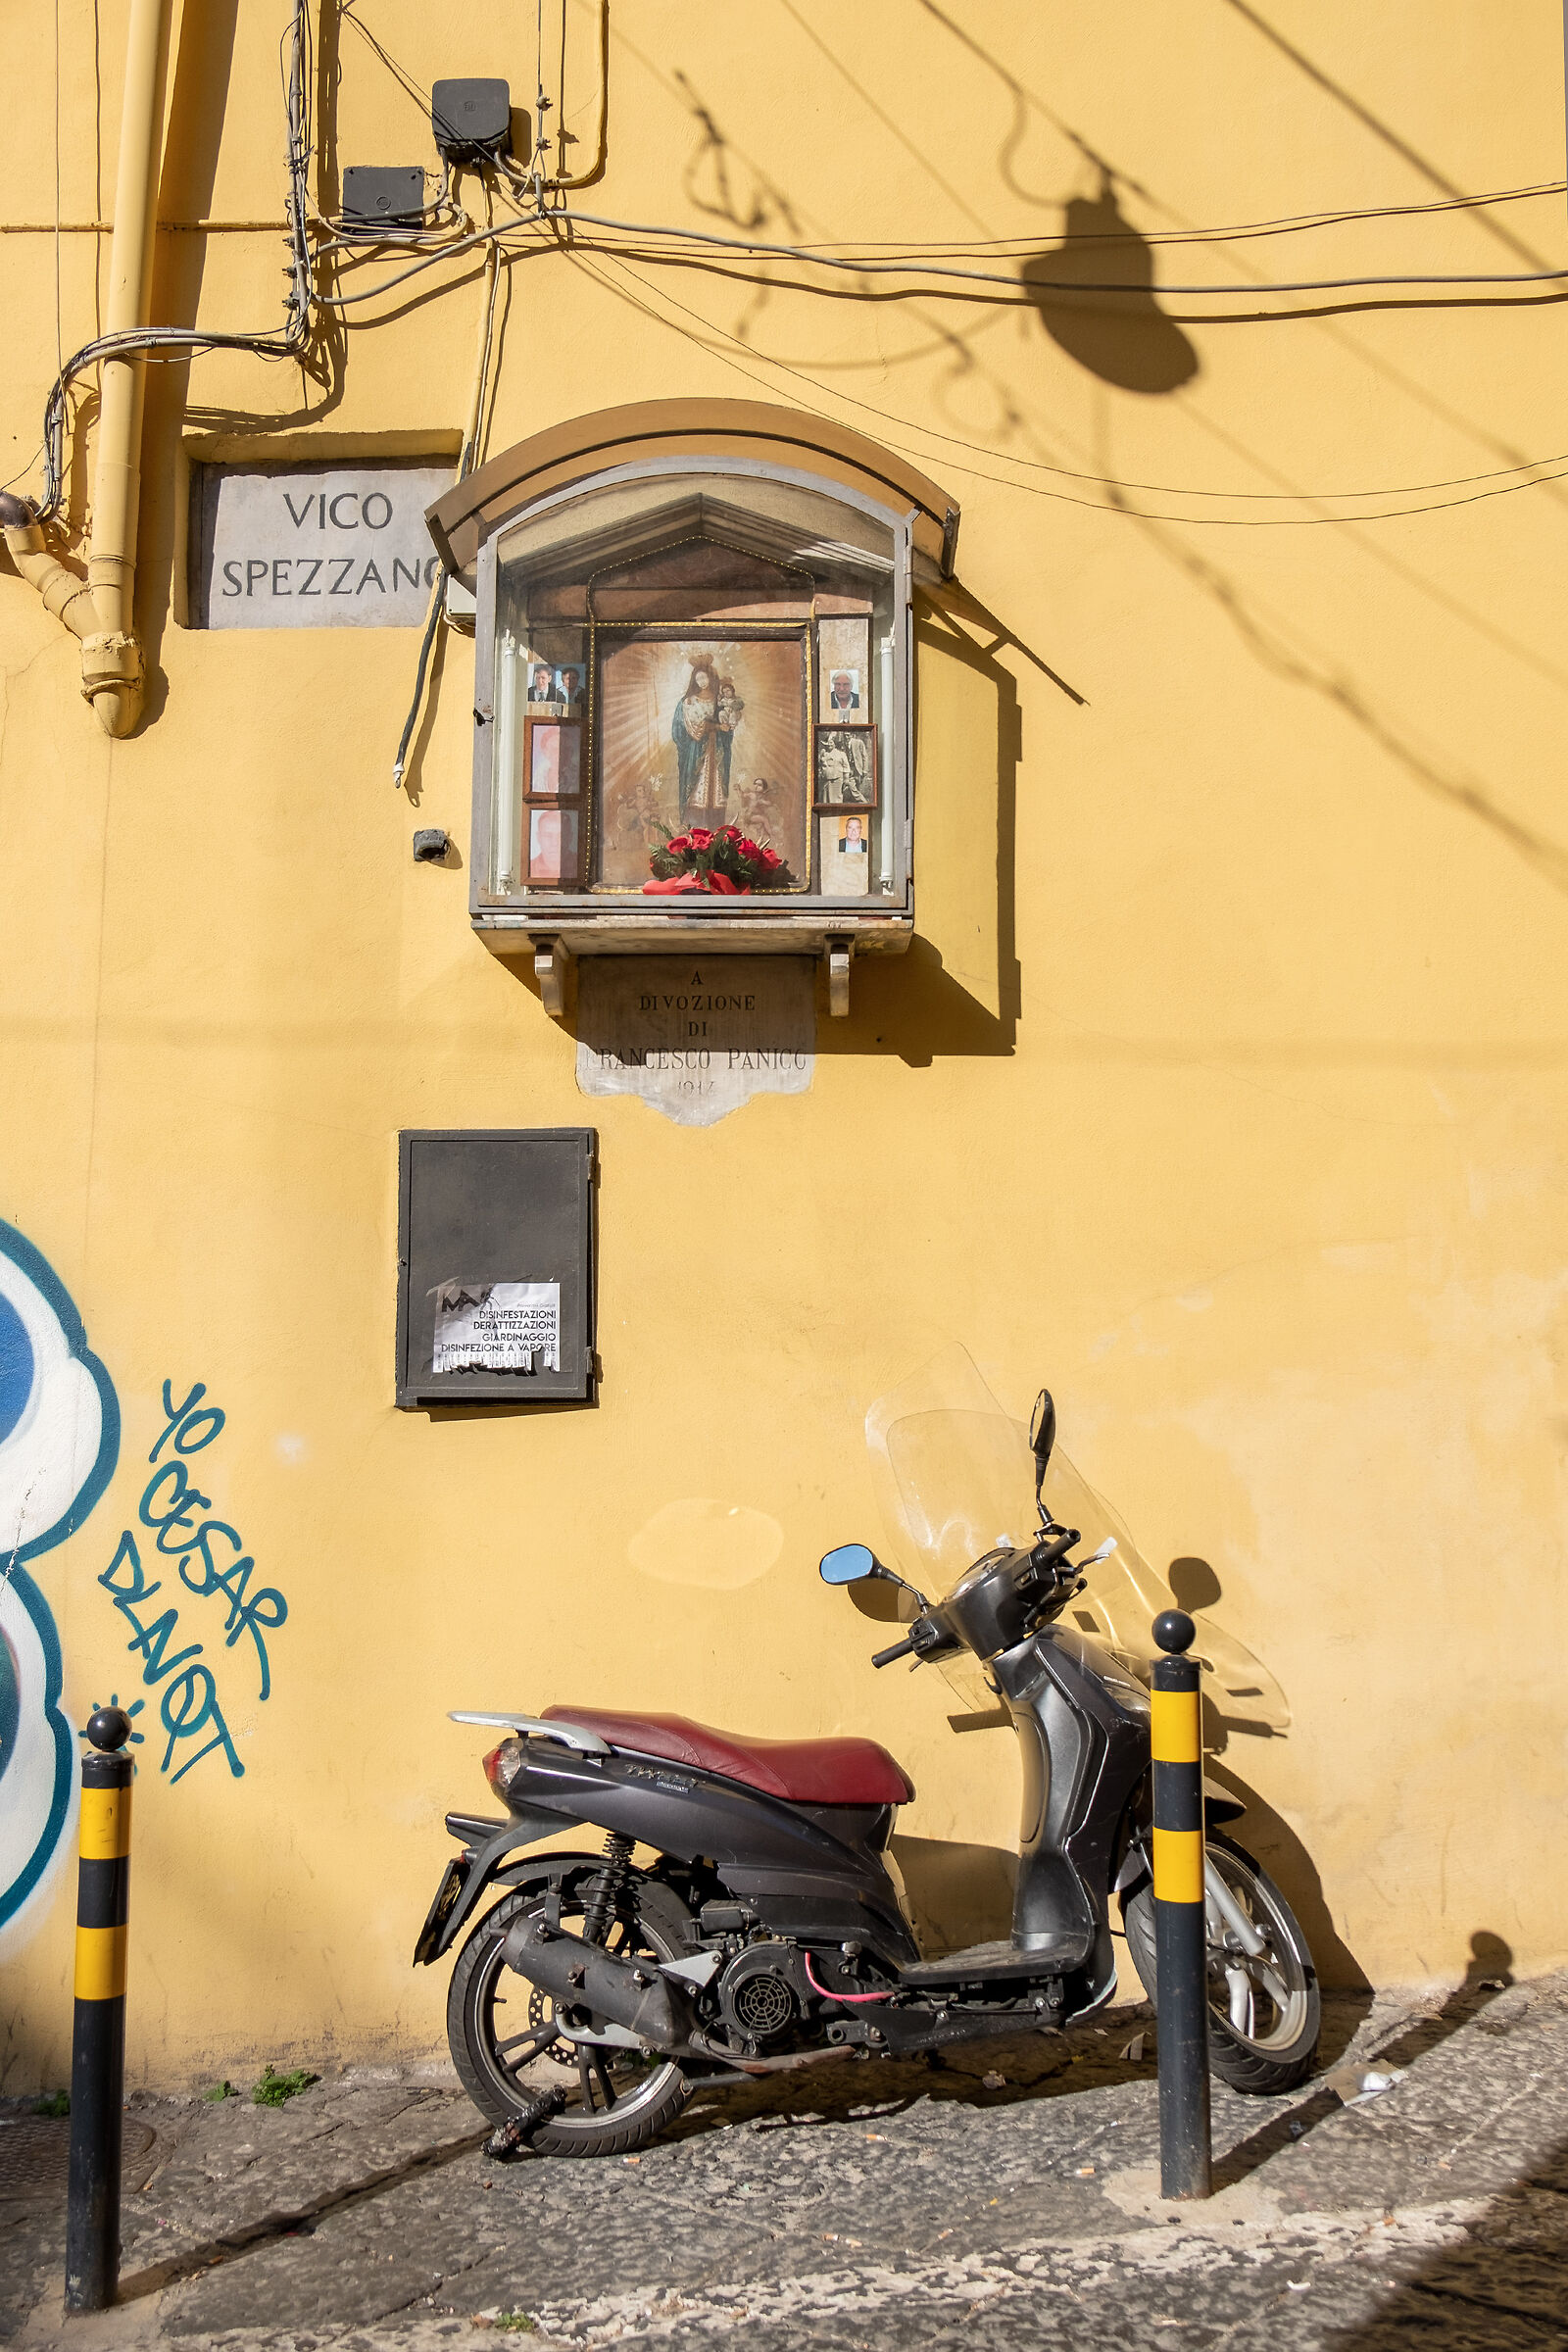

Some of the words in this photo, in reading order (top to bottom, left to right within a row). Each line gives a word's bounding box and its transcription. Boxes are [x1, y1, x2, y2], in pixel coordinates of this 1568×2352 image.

[283, 492, 393, 529] VICO
[690, 970, 704, 986] A
[639, 995, 756, 1011] DIVOZIONE
[688, 1021, 708, 1037] DI
[727, 1047, 807, 1070] PANICO
[479, 1309, 557, 1319] DISINFESTAZIONI
[473, 1320, 557, 1330] DERATTIZZAZIONI
[482, 1332, 557, 1342] GIARDINAGGIO
[441, 1343, 505, 1352] DISINFEZIONE
[149, 1378, 225, 1463] YO
[138, 1460, 288, 1701] CESAR
